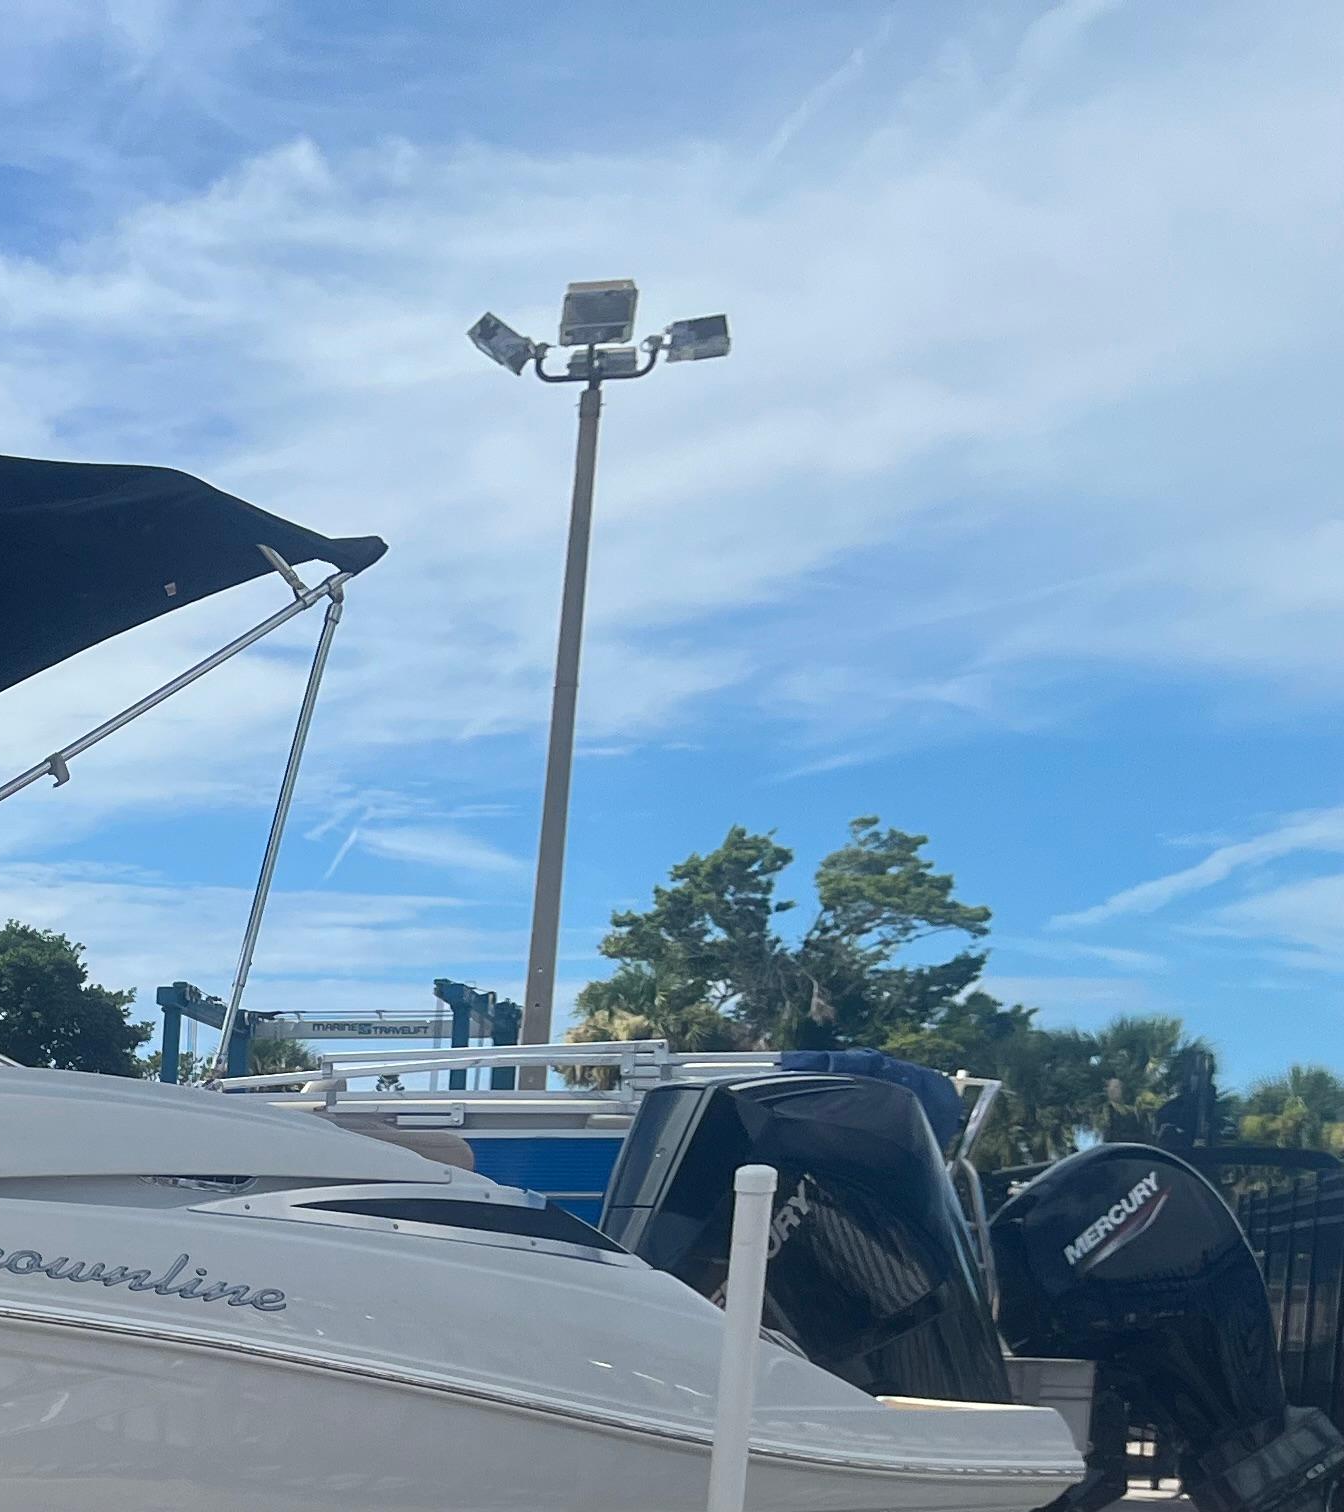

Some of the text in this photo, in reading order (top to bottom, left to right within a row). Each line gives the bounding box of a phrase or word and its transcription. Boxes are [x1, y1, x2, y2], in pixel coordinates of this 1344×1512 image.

[312, 1022, 429, 1035] MARINE TRAVELIFT
[1063, 1170, 1160, 1265] MERCURY
